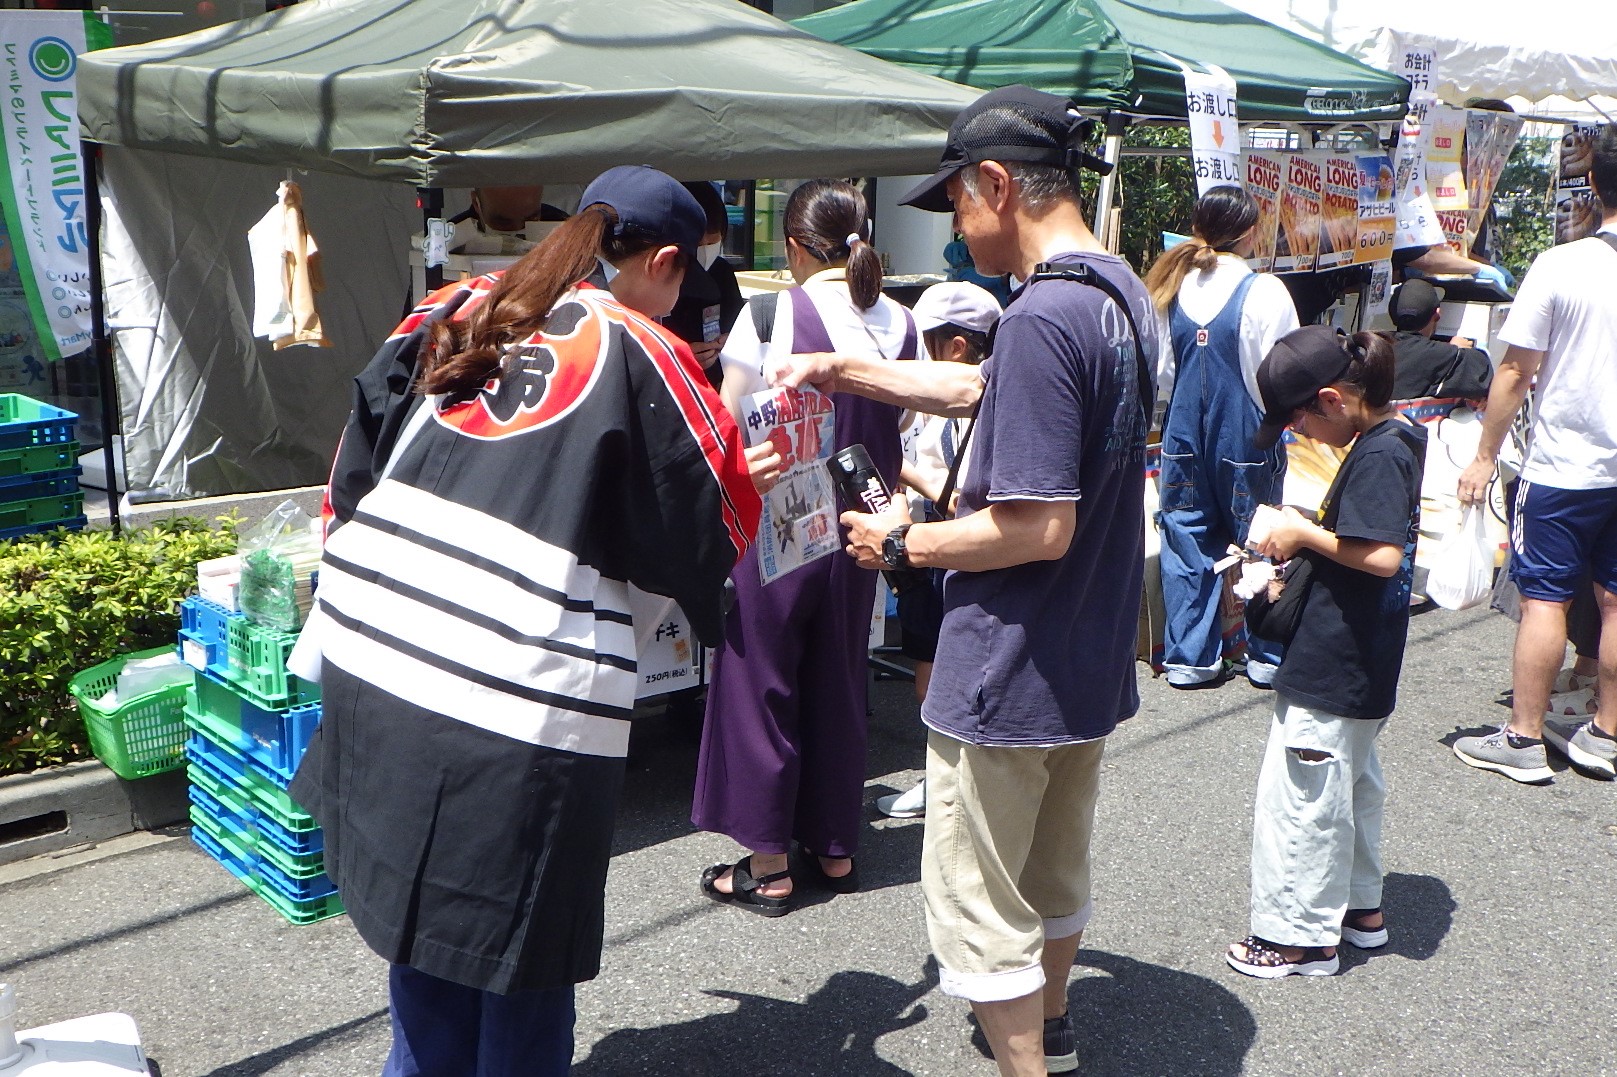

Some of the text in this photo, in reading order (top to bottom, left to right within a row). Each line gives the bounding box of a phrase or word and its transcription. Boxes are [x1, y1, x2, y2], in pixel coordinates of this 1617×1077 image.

[1404, 52, 1431, 71] お会計
[1188, 91, 1237, 118] お渡し口
[1410, 103, 1427, 121] 会計
[1195, 157, 1240, 181] お渡し口
[1248, 155, 1281, 173] AMERICAN
[1248, 164, 1280, 191] LONG
[1288, 166, 1321, 192] LONG
[1327, 166, 1358, 190] LONG
[1325, 193, 1358, 212] POTATO
[1360, 202, 1396, 217] アサヒビール
[1360, 231, 1393, 249] 600円
